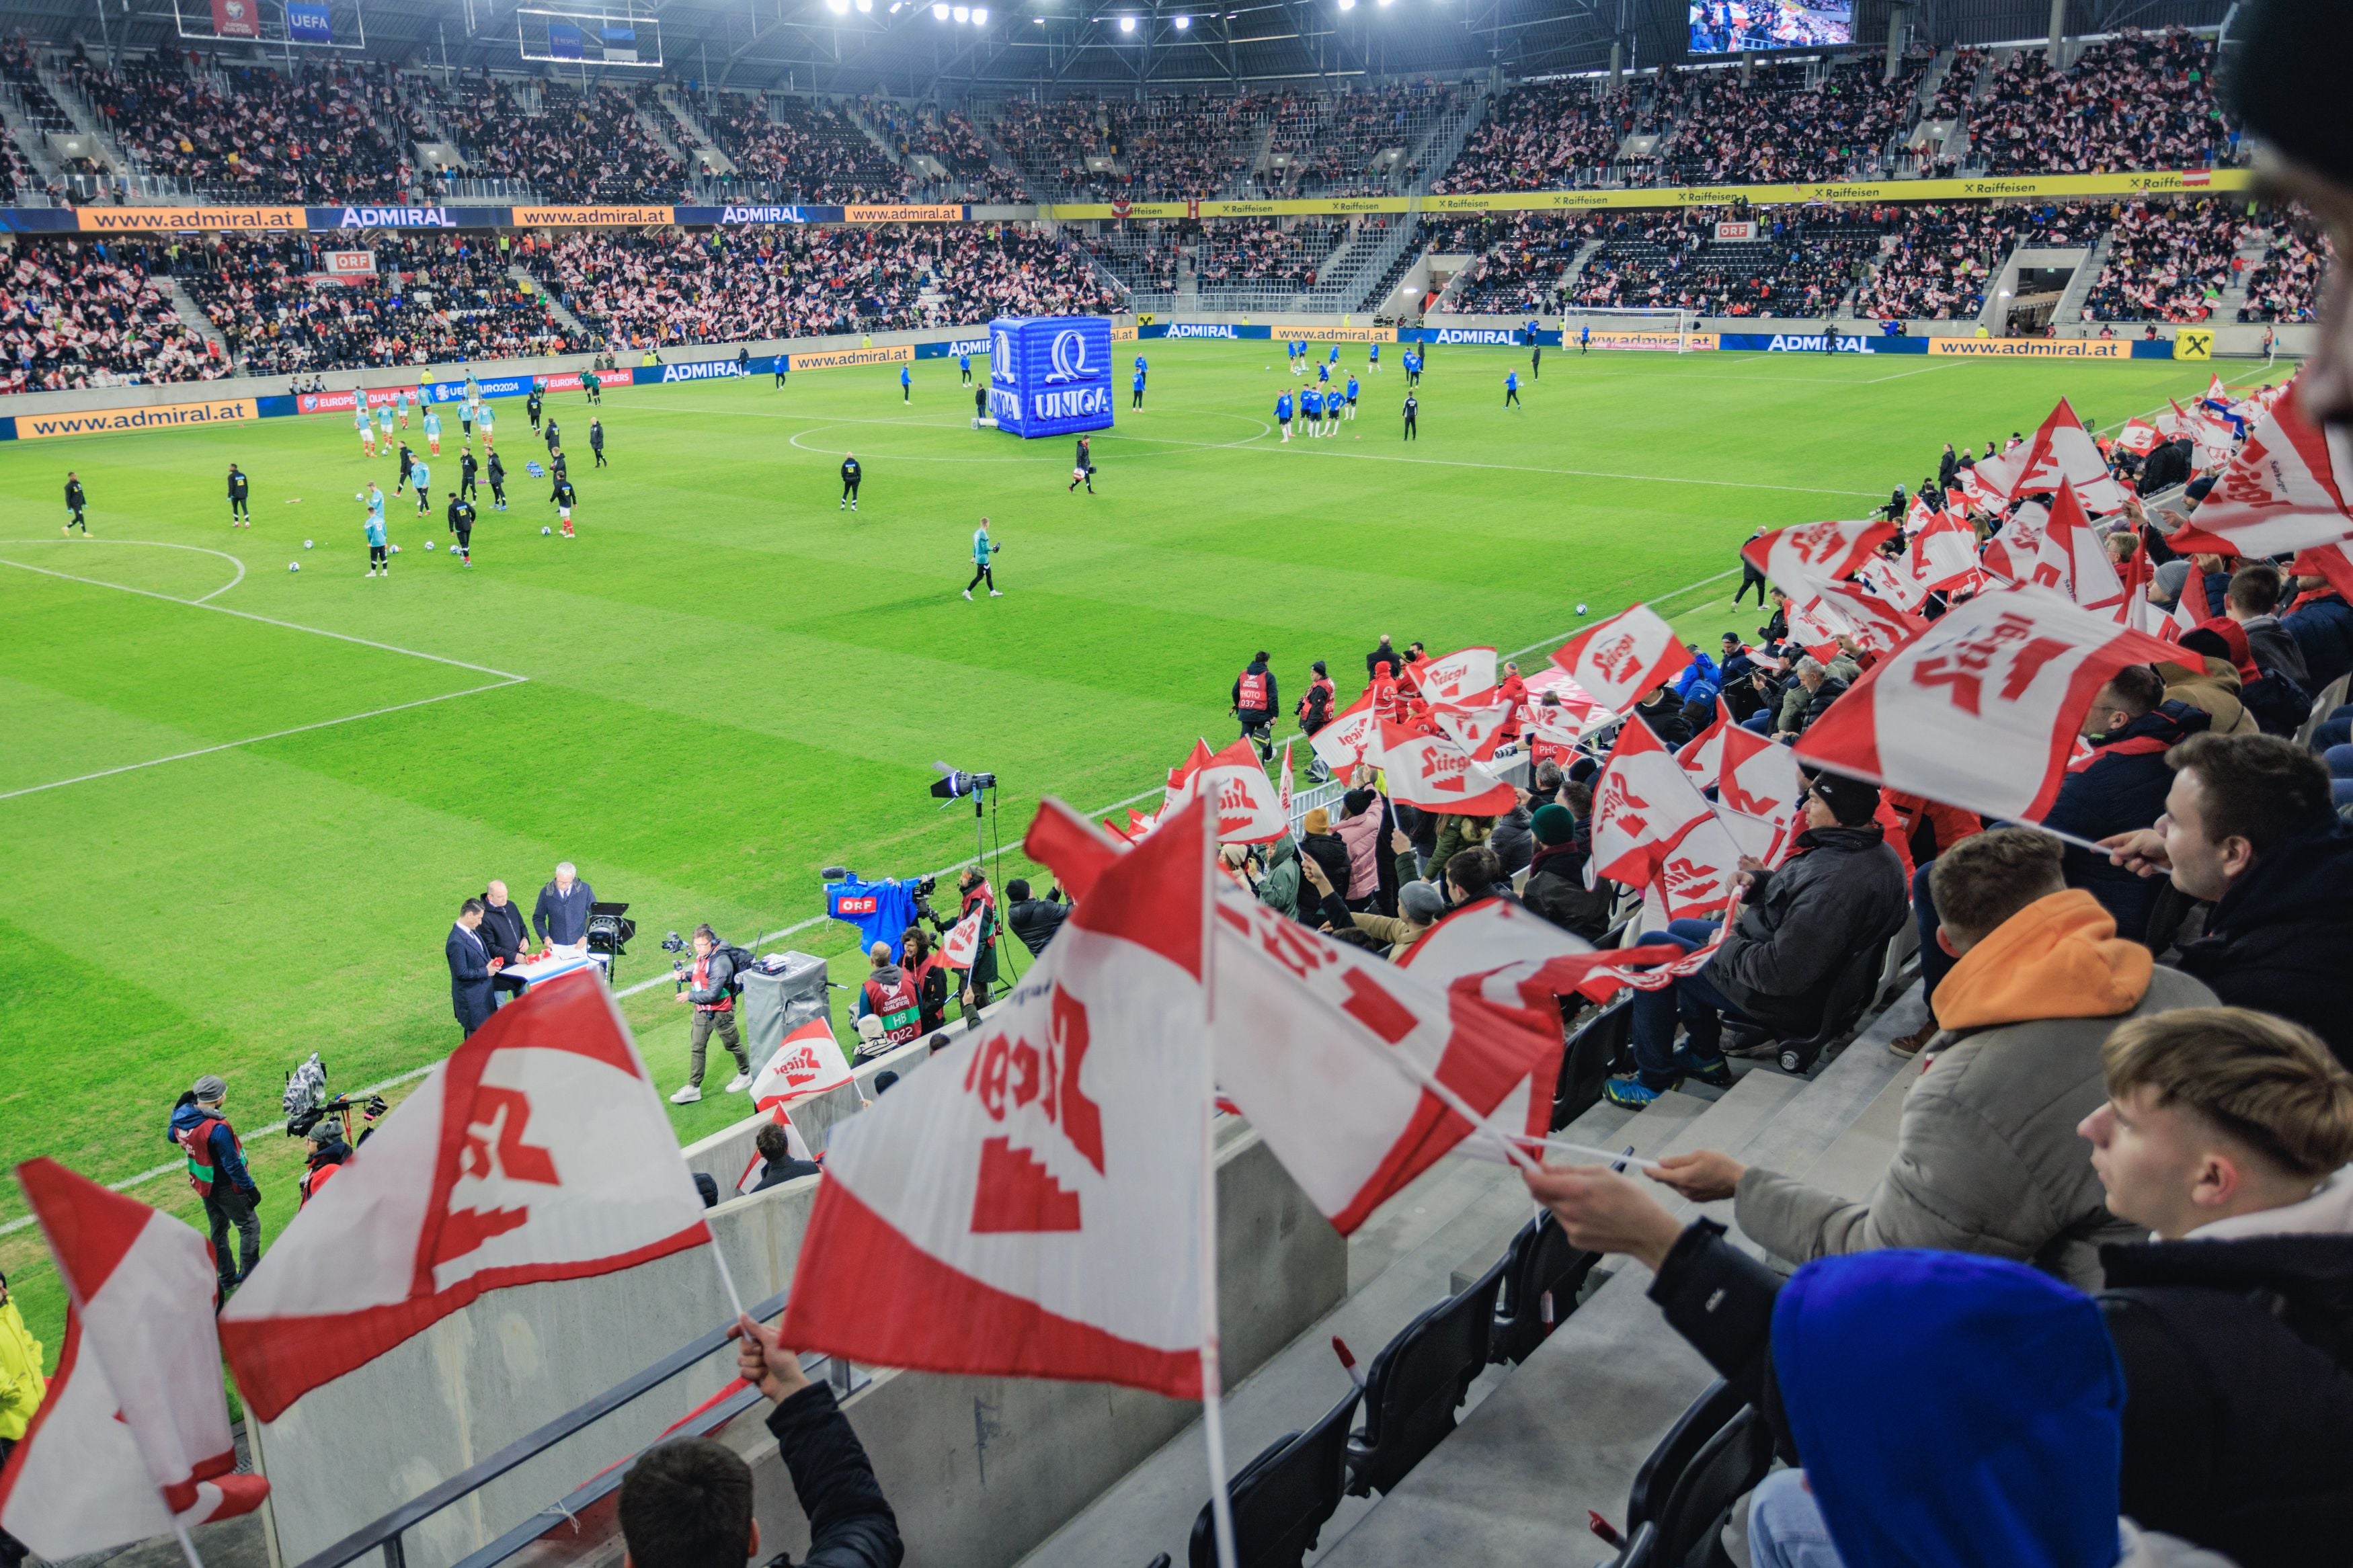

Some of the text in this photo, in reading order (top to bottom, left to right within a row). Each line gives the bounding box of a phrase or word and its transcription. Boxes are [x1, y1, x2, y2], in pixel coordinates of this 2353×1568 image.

[290, 15, 328, 29] UEFA
[1977, 183, 2036, 192] Raiffeisen
[2143, 177, 2182, 188] Raiffe
[1688, 192, 1737, 202] Raiffeisen
[1826, 188, 1880, 197] Raiffeisen
[1447, 199, 1489, 208] Raiffeisen
[1563, 196, 1607, 204] Raiffeisen
[722, 206, 804, 223] ADMIRAL
[852, 207, 955, 220] www.admiral.at
[1133, 207, 1162, 215] ffeisen
[1232, 204, 1273, 212] Raiffeisen
[93, 210, 294, 227] www.admiral.at
[341, 206, 456, 228] ADMIRAL
[524, 209, 664, 223] www.admiral.at
[1721, 226, 1747, 235] ORF
[338, 256, 367, 267] ORF
[1166, 324, 1237, 339] ADMIRAL
[1279, 329, 1389, 341] www.admiral.at
[1435, 329, 1520, 345] ADMIRAL
[1767, 334, 1874, 354] ADMIRAL
[1941, 341, 2118, 356] www.admiral.at
[797, 348, 908, 368] www.admiral.at
[662, 361, 751, 383] ADMIRAL
[479, 382, 519, 393] URO2024
[1035, 387, 1110, 421] UNIQA
[34, 403, 245, 434] www.admiral.at
[1429, 664, 1468, 687] Stiegl
[1241, 700, 1255, 708] 037
[1539, 745, 1558, 754] PHO
[842, 900, 873, 911] ORF
[883, 999, 910, 1012] QUALIFIERS
[884, 995, 908, 1006] EUROPEAN
[892, 1013, 907, 1027] HB
[891, 1026, 914, 1042] 022
